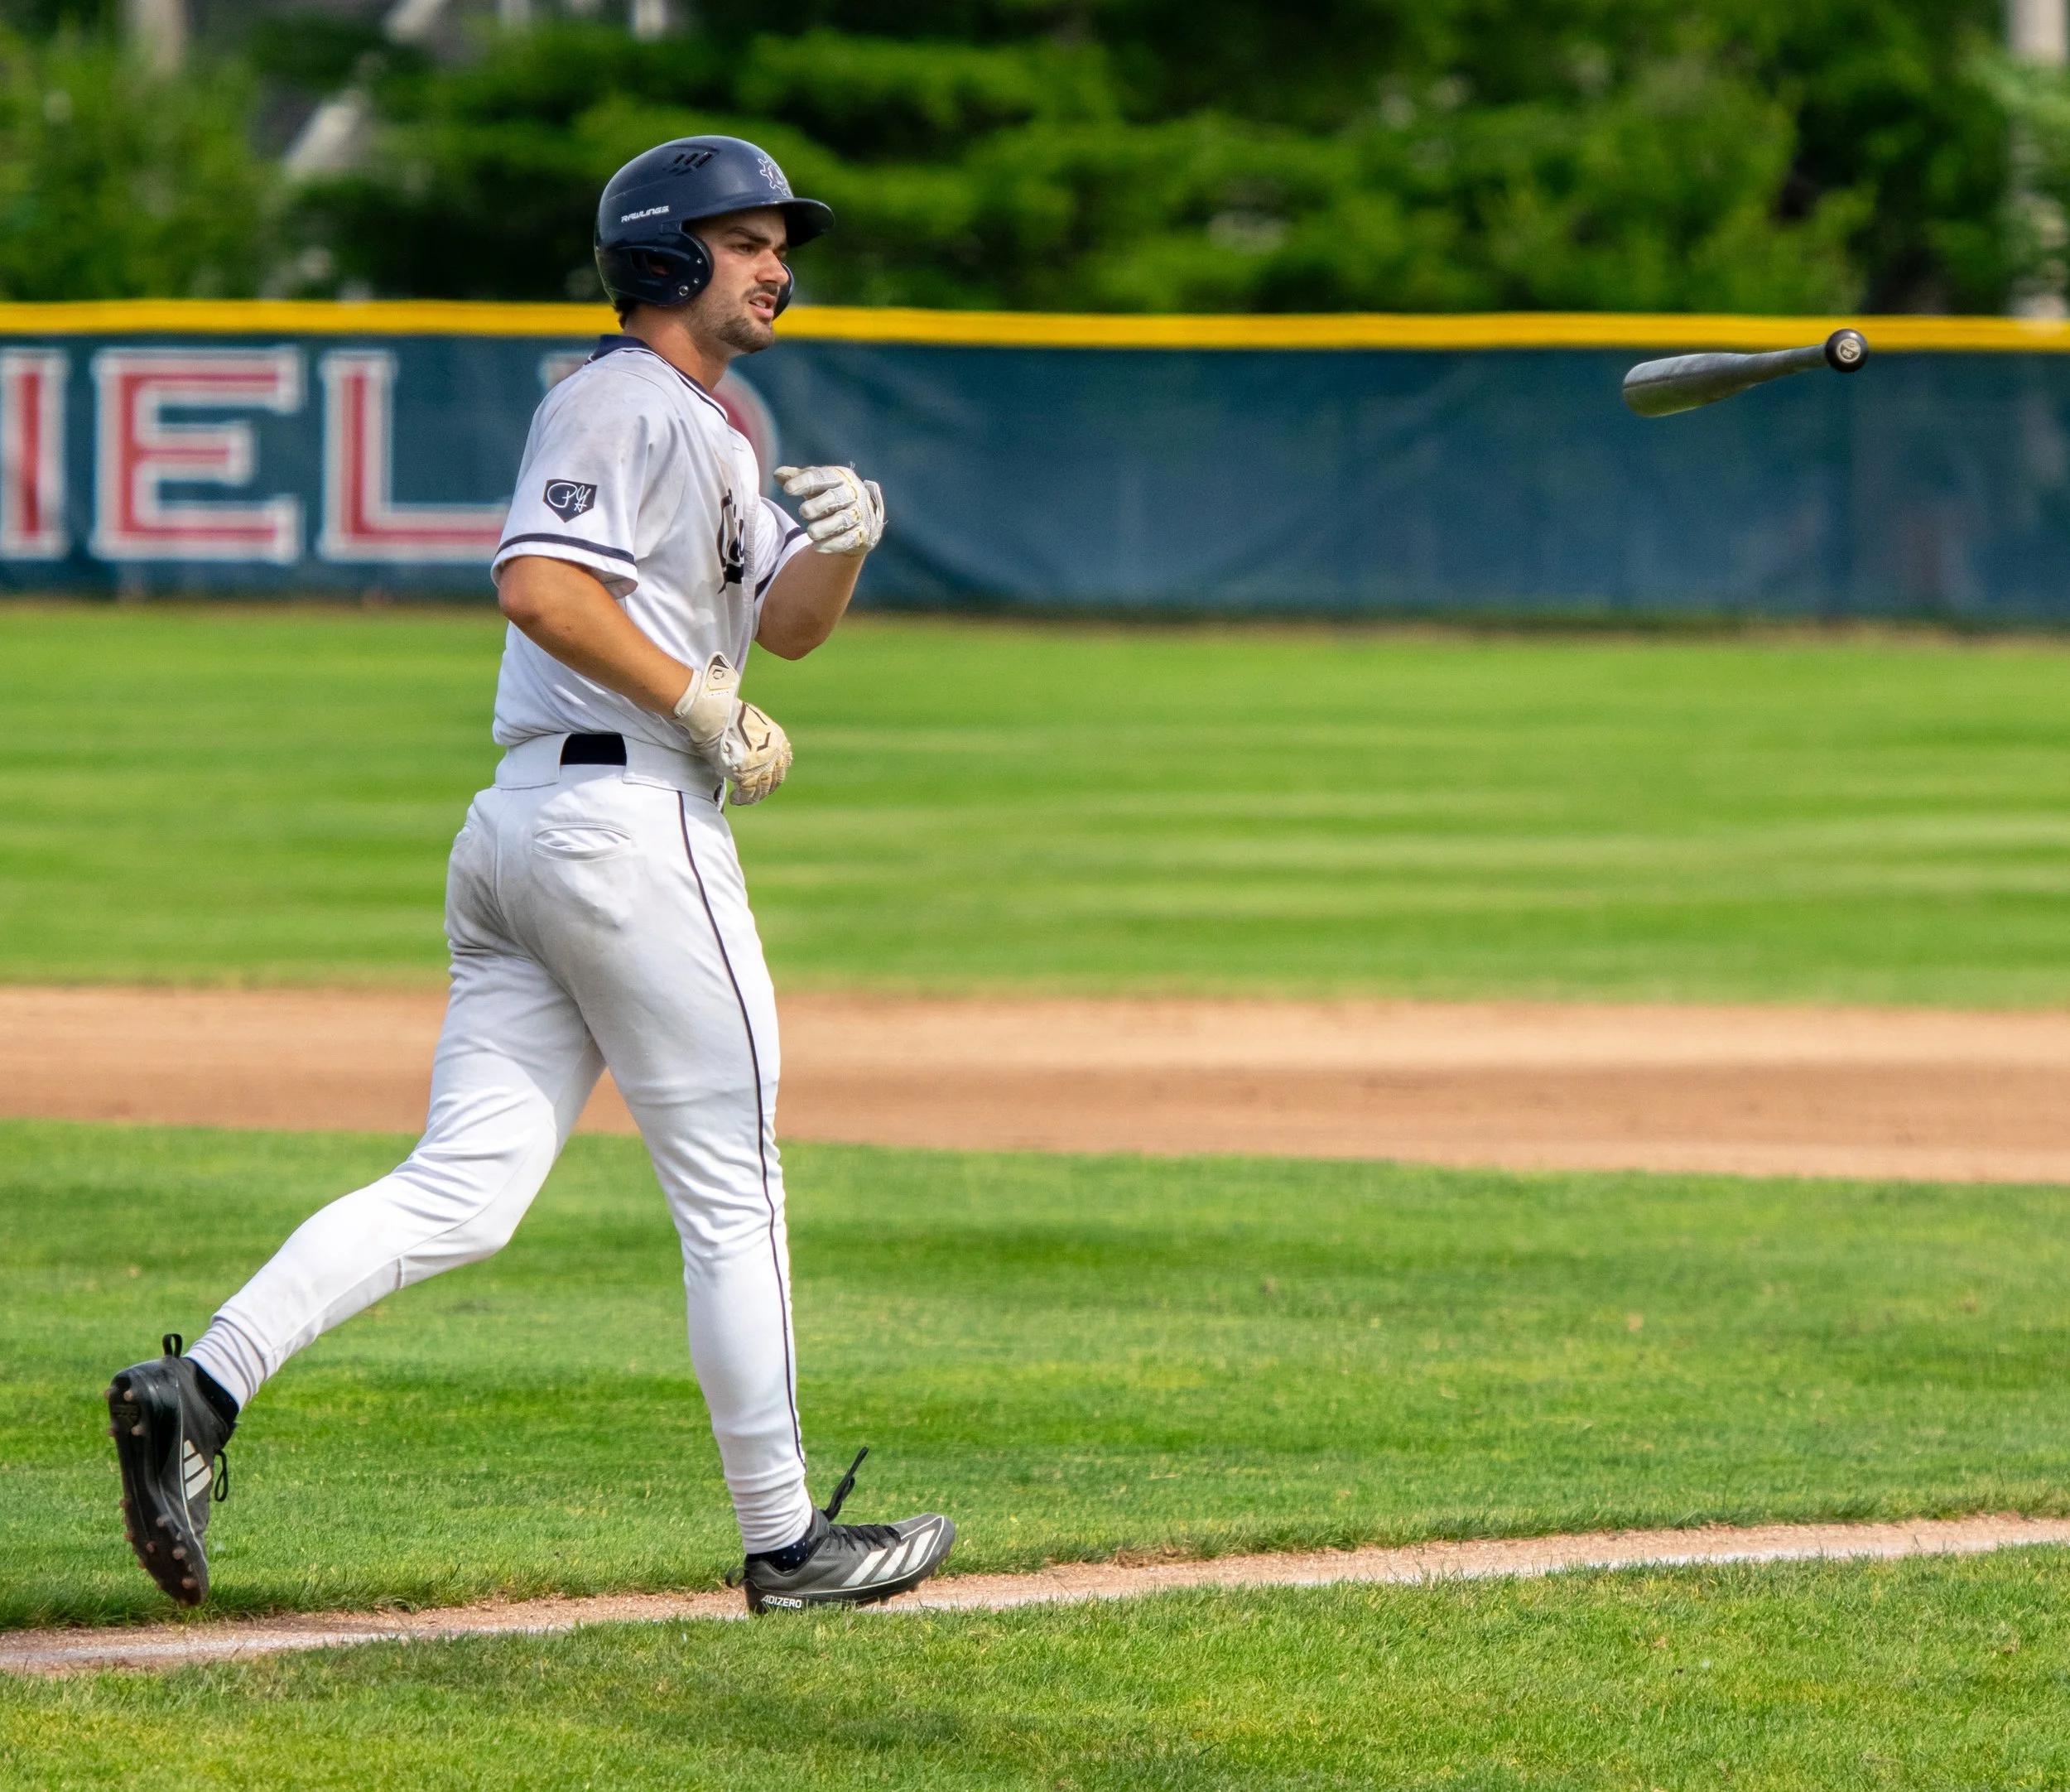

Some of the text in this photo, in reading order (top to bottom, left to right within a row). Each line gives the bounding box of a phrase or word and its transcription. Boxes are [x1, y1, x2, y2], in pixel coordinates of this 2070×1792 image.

[621, 205, 669, 223] RAWLINGS
[0, 346, 781, 563] IEL
[761, 1594, 802, 1608] ADIZERO
